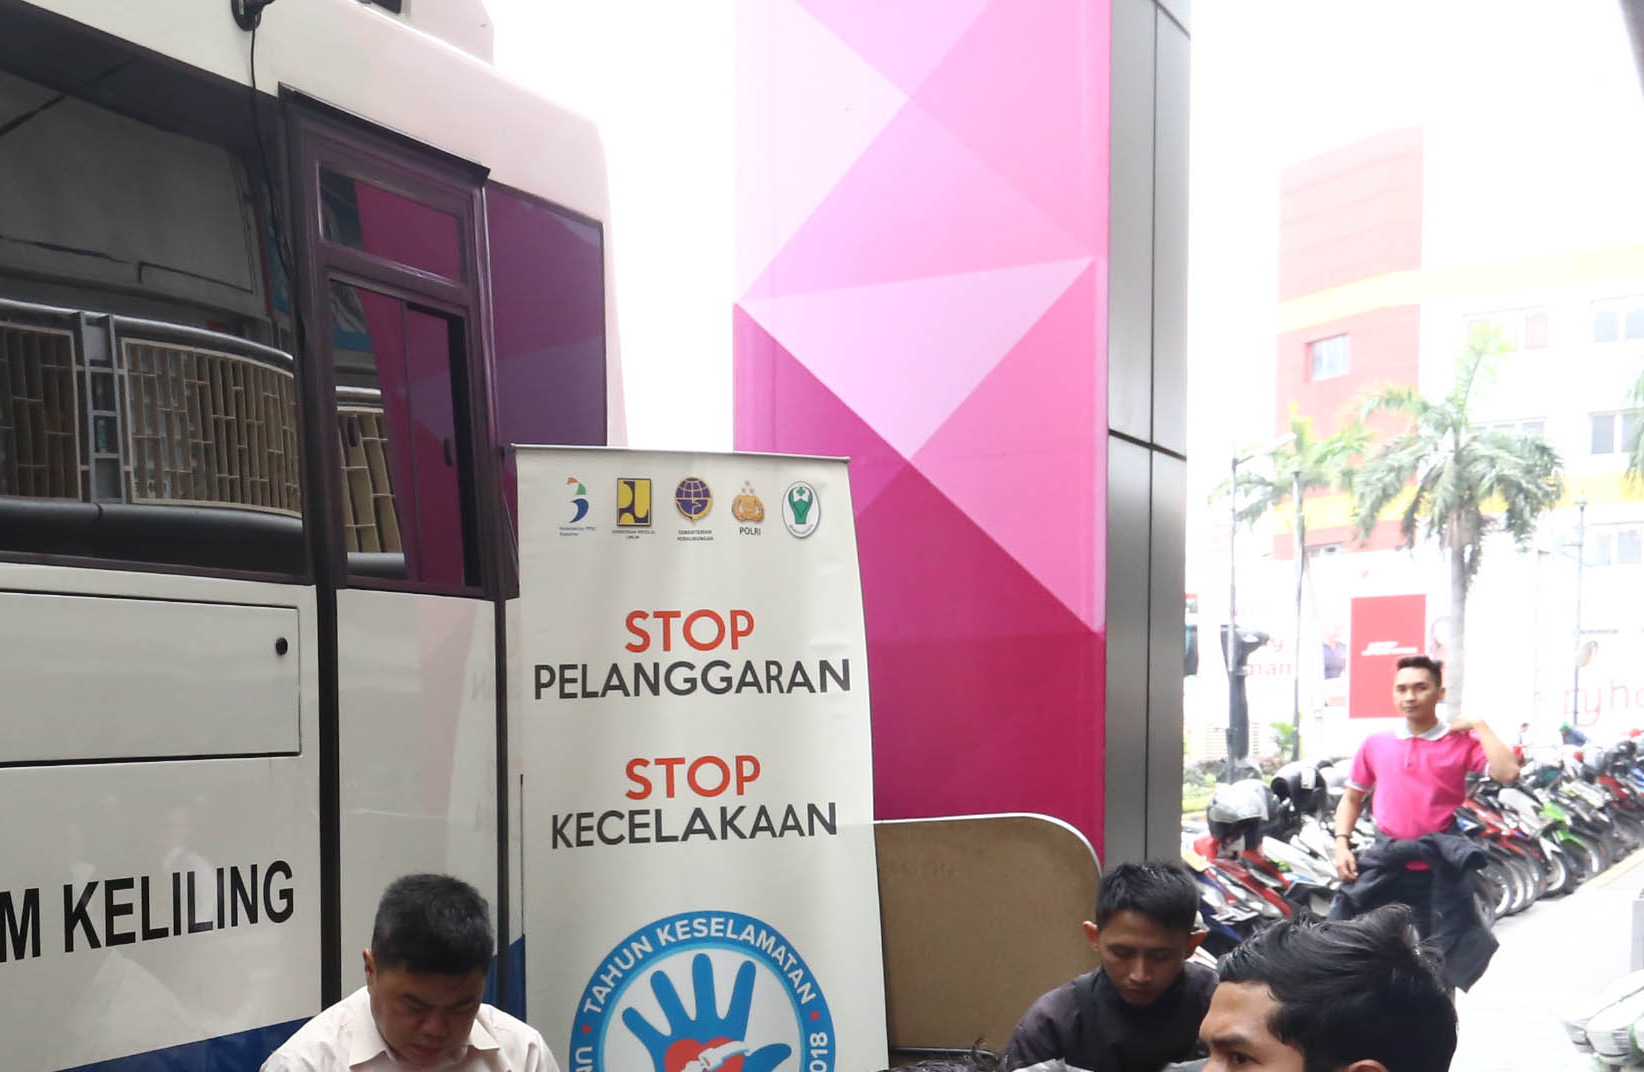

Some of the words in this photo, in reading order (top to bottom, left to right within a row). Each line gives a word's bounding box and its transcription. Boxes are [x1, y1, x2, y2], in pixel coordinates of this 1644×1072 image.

[739, 527, 761, 536] POLRI
[624, 608, 755, 653] STOP
[534, 658, 851, 700] PELANGGARAN
[624, 754, 761, 801] STOP
[551, 801, 837, 849] KECELAKAAN
[61, 860, 295, 953] KELILING
[583, 935, 654, 1014] TAHUN
[656, 917, 816, 1005] KESELAMATAN
